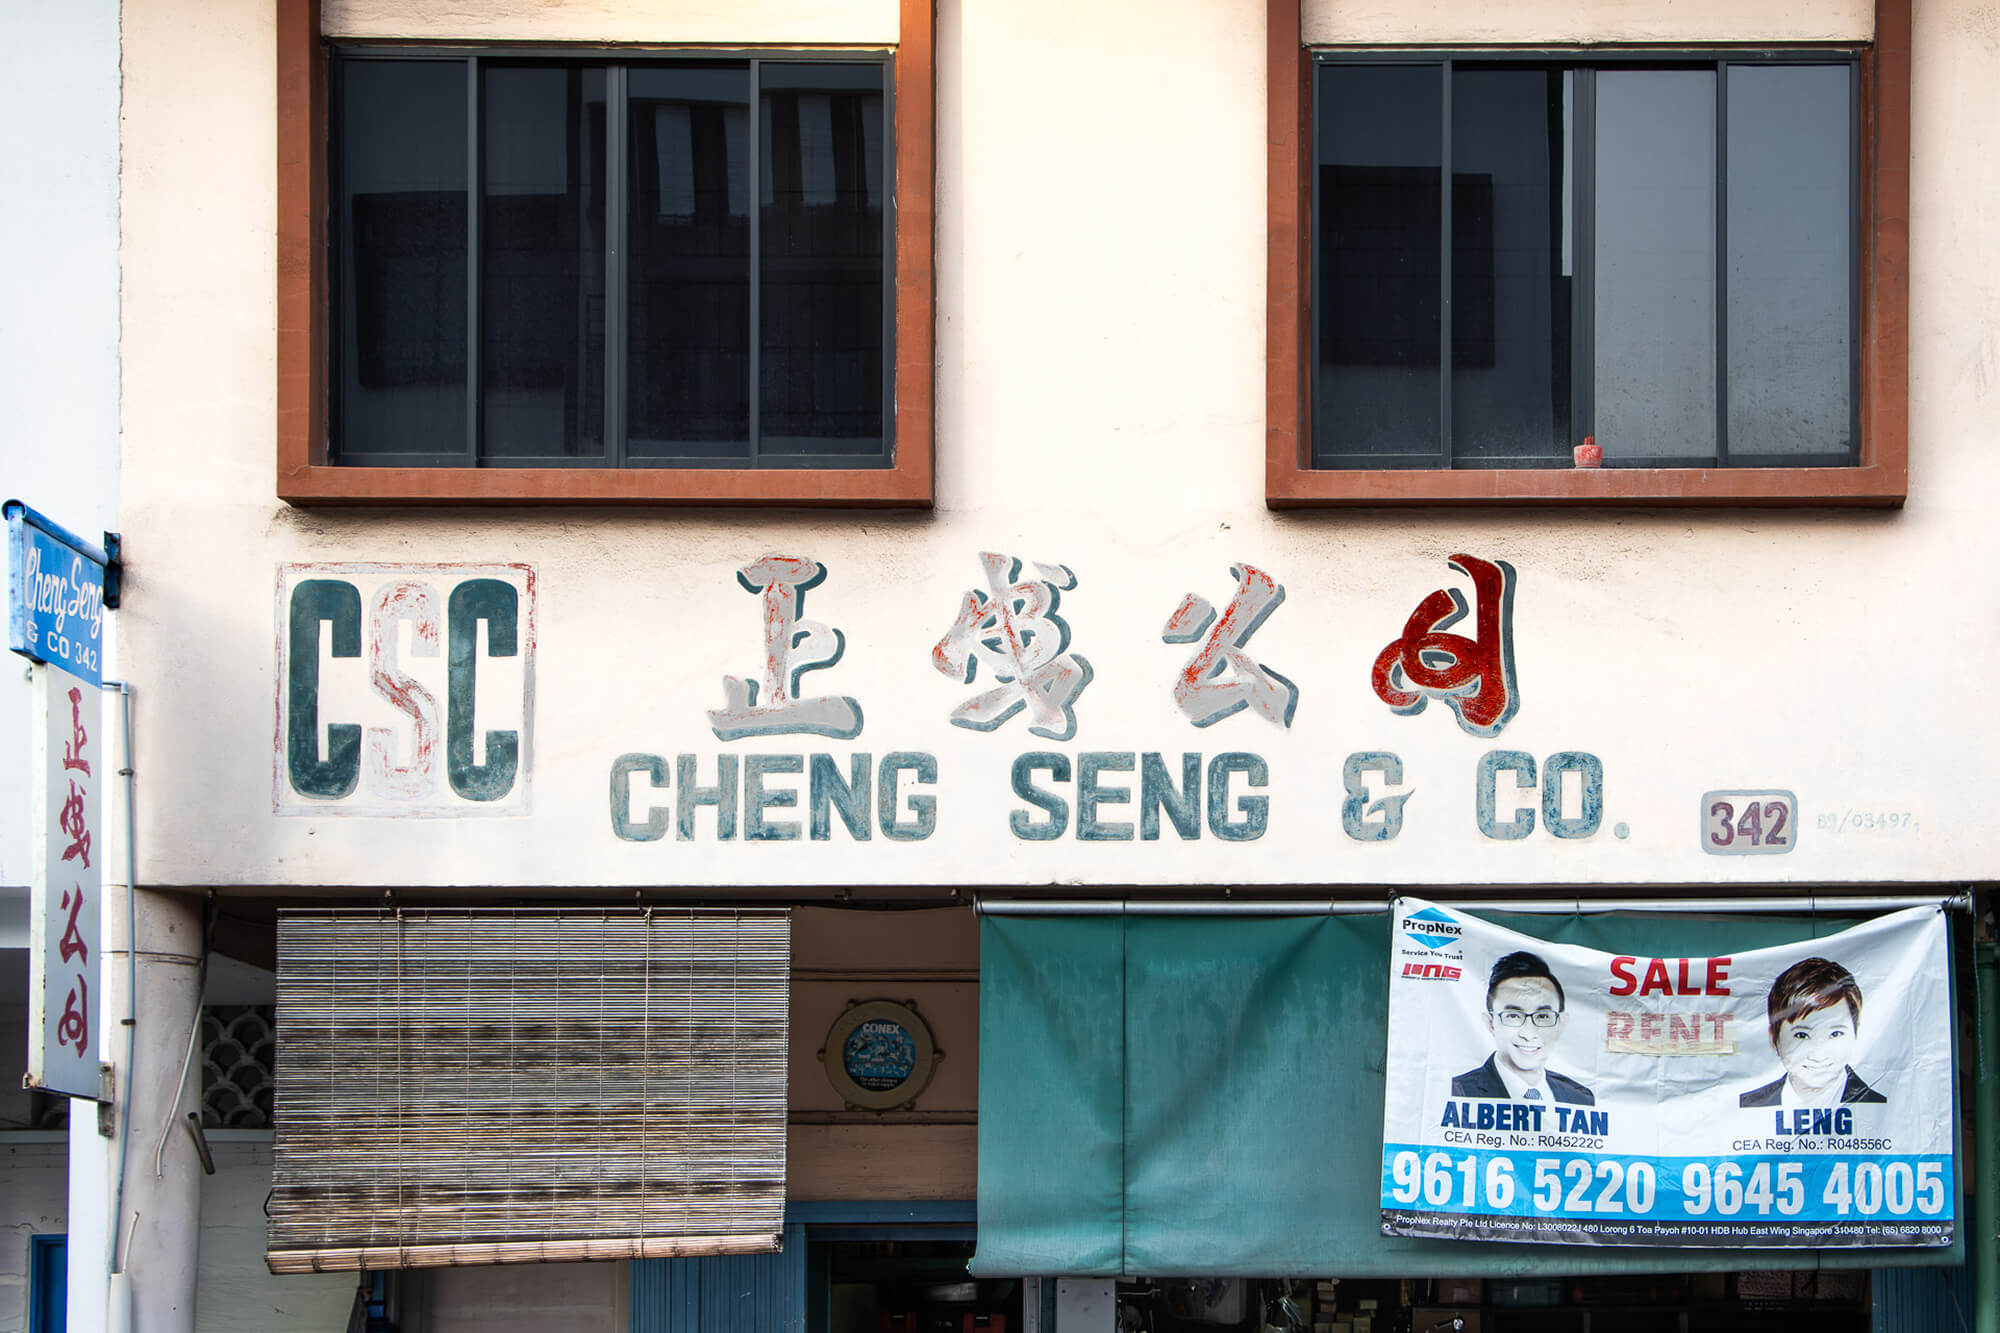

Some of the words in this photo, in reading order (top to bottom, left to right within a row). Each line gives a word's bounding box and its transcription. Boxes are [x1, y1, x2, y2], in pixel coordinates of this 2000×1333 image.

[24, 546, 68, 634] Cheng
[68, 556, 103, 639] Seng
[74, 642, 98, 672] 342
[288, 577, 519, 802] CSC
[610, 751, 938, 842] CHENG
[1009, 751, 1270, 842] SENG
[1342, 751, 1415, 842] &
[1475, 749, 1630, 842] CO.
[1710, 801, 1789, 846] 342
[1402, 919, 1462, 935] PropNex
[1609, 956, 1732, 996] SALE
[862, 1023, 901, 1035] CONEX
[1440, 1101, 1546, 1132] ALBERT
[1555, 1107, 1609, 1136] TAN
[1775, 1107, 1853, 1136] LENG
[1444, 1131, 1473, 1144] CEA
[1476, 1133, 1505, 1148] Reg.
[1510, 1134, 1535, 1147] No.:
[1538, 1135, 1604, 1150] R045222C
[1732, 1139, 1761, 1151] CEA
[1765, 1138, 1794, 1153] Reg.
[1799, 1138, 1823, 1150] No.:
[1827, 1138, 1892, 1150] R048556C
[1392, 1151, 1515, 1209] 9616
[1533, 1158, 1656, 1214] 5220
[1682, 1162, 1805, 1216] 9645
[1823, 1162, 1945, 1216] 4005
[1396, 1215, 1431, 1227] PropNex
[1432, 1216, 1458, 1228] Realty
[1475, 1219, 1488, 1228] Ltd
[1489, 1220, 1520, 1231] Licence
[1521, 1222, 1536, 1231] No:
[1583, 1224, 1598, 1233] 480
[1600, 1225, 1628, 1235] Lorong
[1629, 1225, 1635, 1234] 6
[1637, 1225, 1653, 1234] Toa
[1654, 1225, 1680, 1236] Payoh
[1681, 1225, 1708, 1235] #10-01
[1711, 1226, 1730, 1235] HDB
[1731, 1226, 1748, 1235] Hub
[1750, 1226, 1768, 1235] East
[1769, 1226, 1791, 1237] Wing
[1792, 1226, 1832, 1237] Singapore
[1882, 1225, 1899, 1235] (65)
[1899, 1225, 1920, 1235] 6820
[1921, 1225, 1942, 1235] 8000
